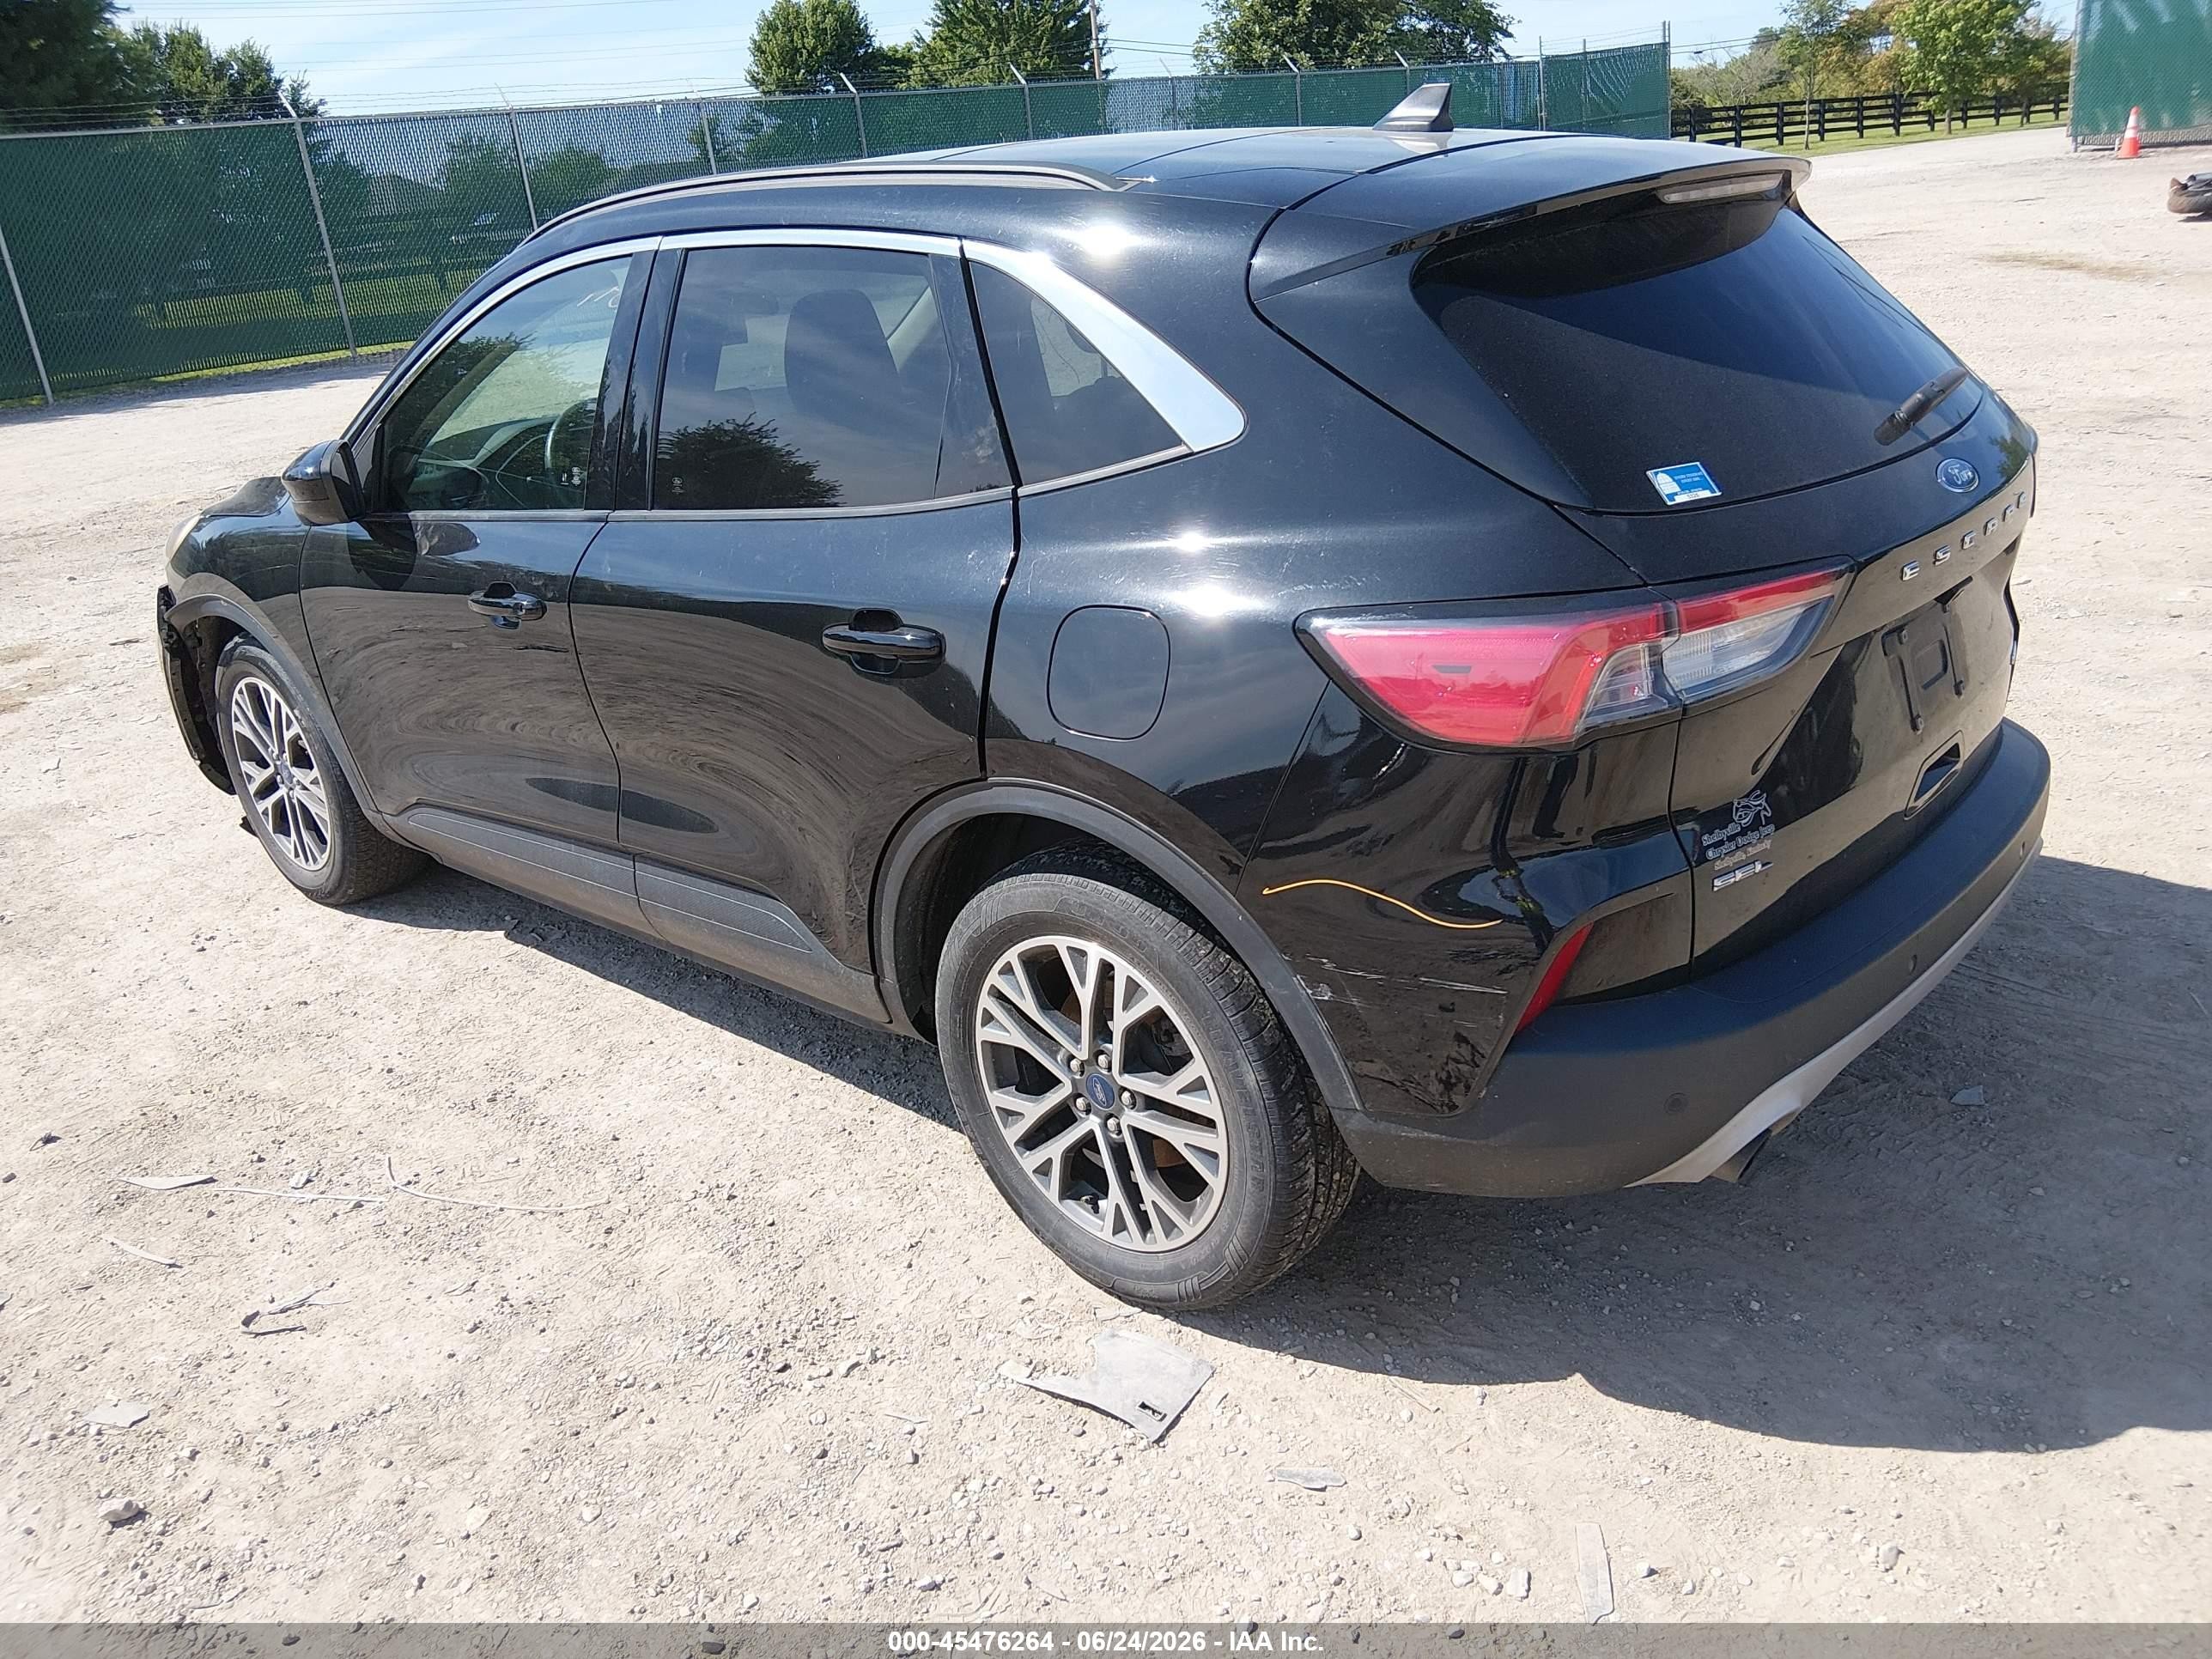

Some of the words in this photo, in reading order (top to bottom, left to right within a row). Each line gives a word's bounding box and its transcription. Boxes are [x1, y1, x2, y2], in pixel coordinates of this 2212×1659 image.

[1901, 491, 2027, 581] ESCAPE
[1701, 822, 1741, 846] Shelbyville
[1705, 841, 1736, 860] Chrysler
[1735, 830, 1760, 847] Dodge
[1759, 823, 1776, 838] Jeep
[1713, 860, 1774, 891] SEL
